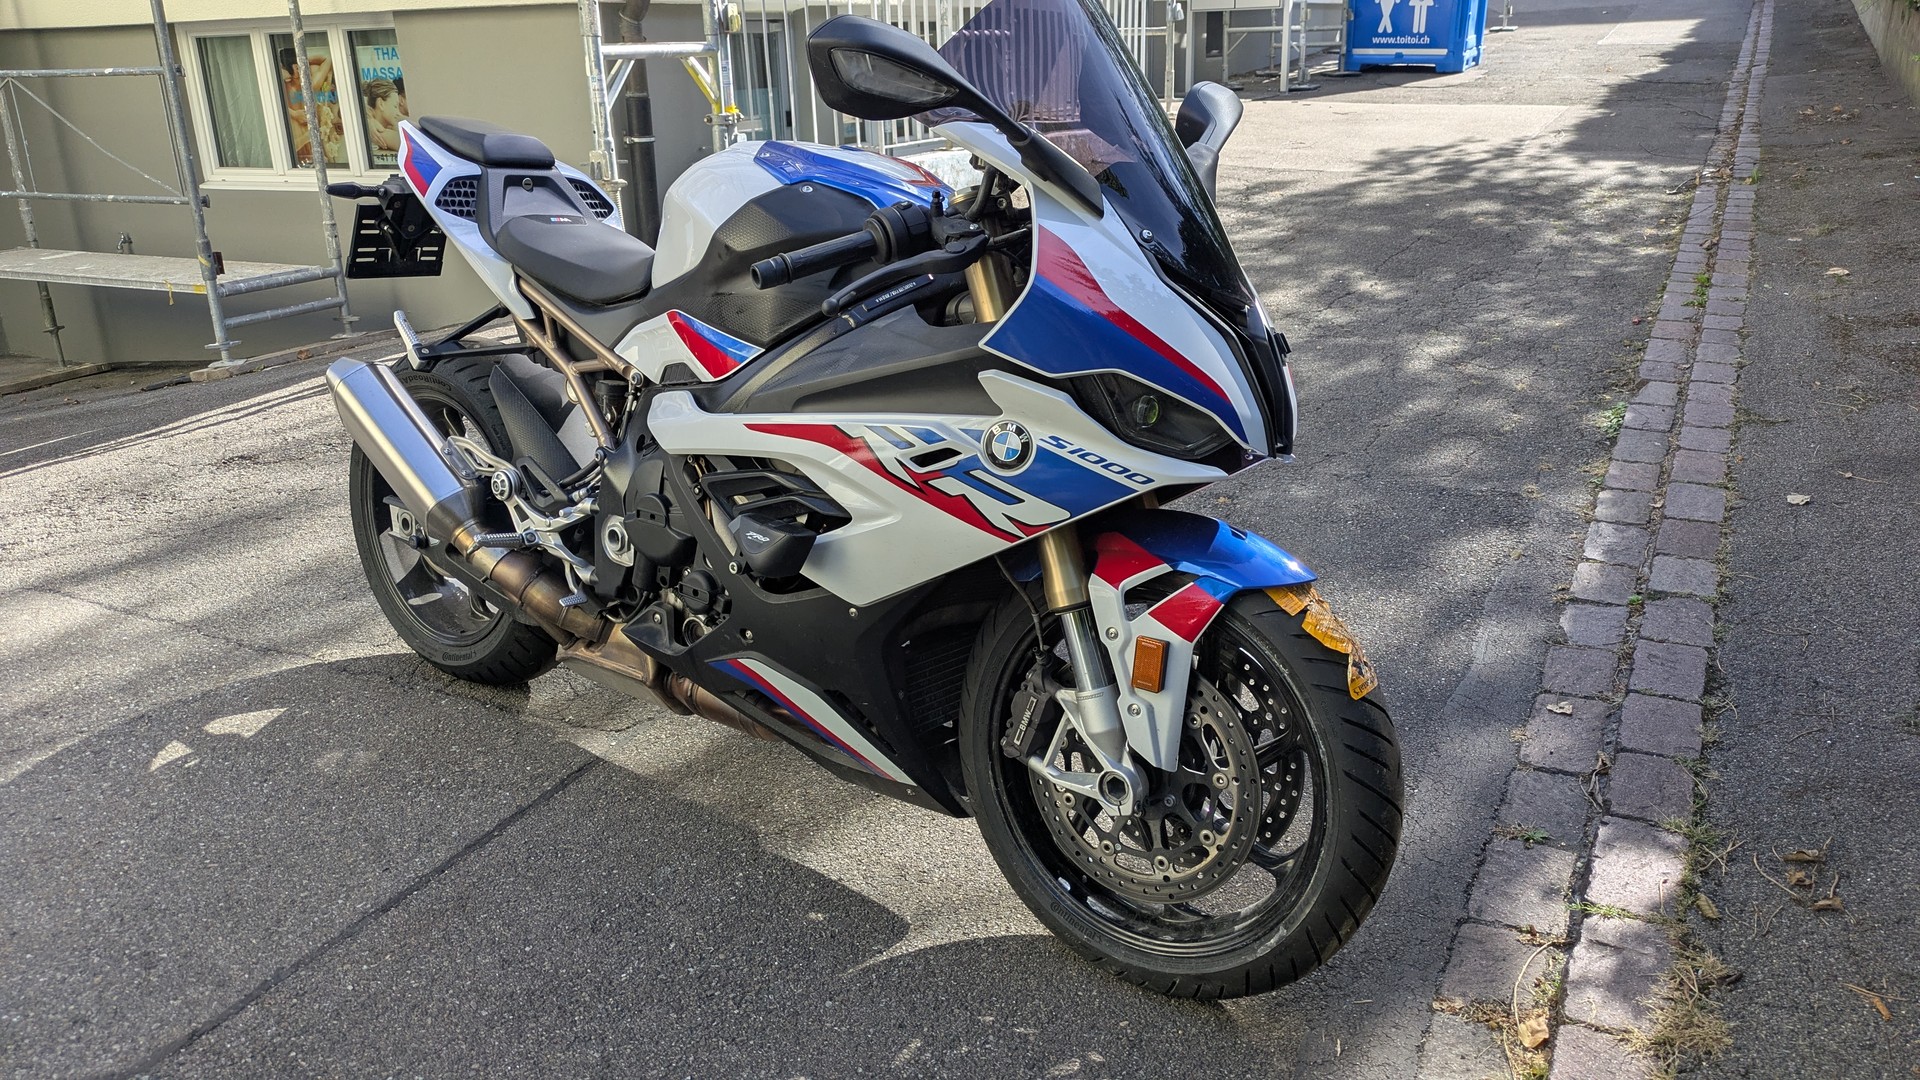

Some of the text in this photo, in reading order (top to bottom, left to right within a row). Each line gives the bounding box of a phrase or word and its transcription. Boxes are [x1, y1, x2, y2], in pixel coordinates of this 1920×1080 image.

[1372, 35, 1430, 45] www.toitoi.ch
[374, 47, 399, 60] THA
[361, 67, 403, 81] MASSA
[991, 422, 1029, 443] BMW
[1039, 435, 1155, 486] S1000
[1019, 708, 1031, 731] BMW
[1050, 901, 1098, 939] Continental
